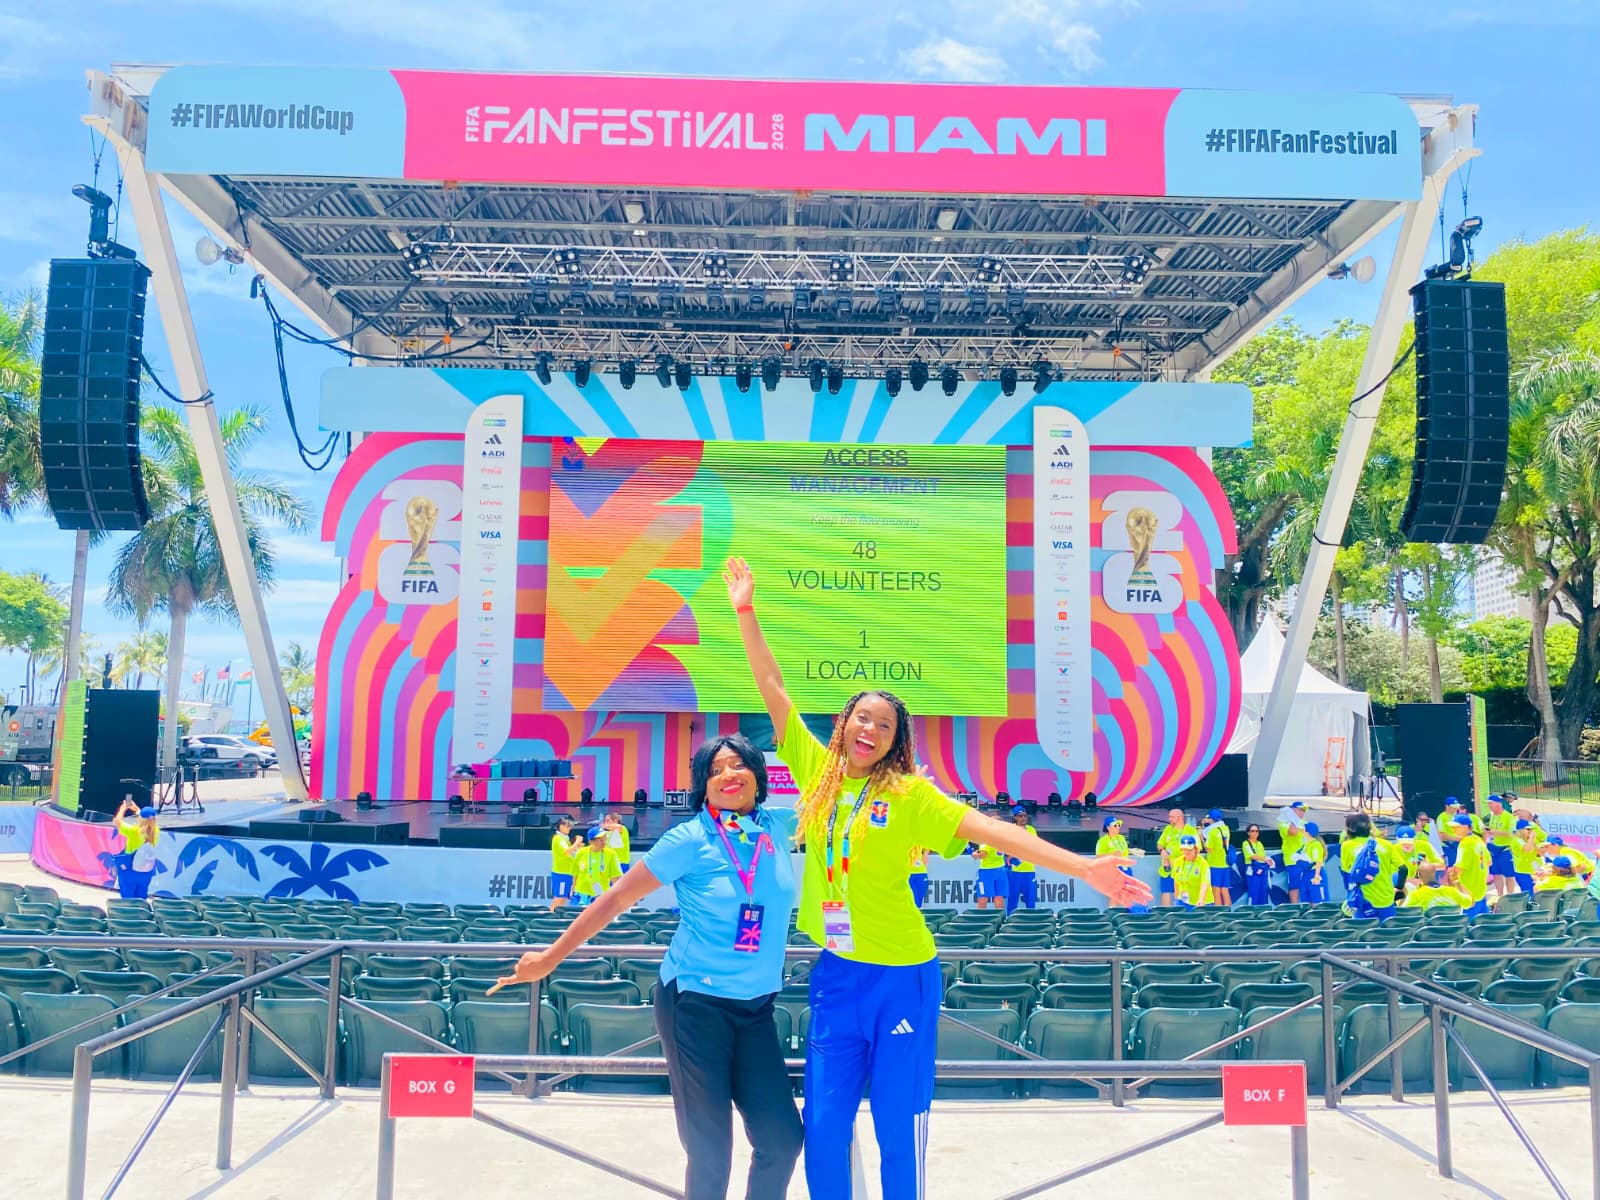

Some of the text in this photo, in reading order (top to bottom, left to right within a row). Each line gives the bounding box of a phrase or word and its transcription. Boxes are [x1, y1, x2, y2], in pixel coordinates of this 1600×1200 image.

[171, 103, 354, 135] #FIFAWorldCup
[465, 106, 480, 142] FIFA
[771, 113, 784, 150] 2026
[804, 113, 1107, 156] MIAMI
[1205, 128, 1397, 155] #FIFAFanFestival
[823, 449, 909, 467] ACCESS
[789, 475, 943, 495] MANAGEMENT
[480, 531, 501, 539] VISA
[852, 541, 877, 559] 48
[1052, 541, 1073, 549] VISA
[401, 581, 439, 593] FIFA
[788, 570, 942, 591] VOLUNTEERS
[1127, 589, 1162, 602] FIFA
[859, 630, 869, 649] 1
[806, 660, 922, 681] LOCATION
[408, 1080, 456, 1094] BOX G
[1243, 1089, 1286, 1102] BOX F
